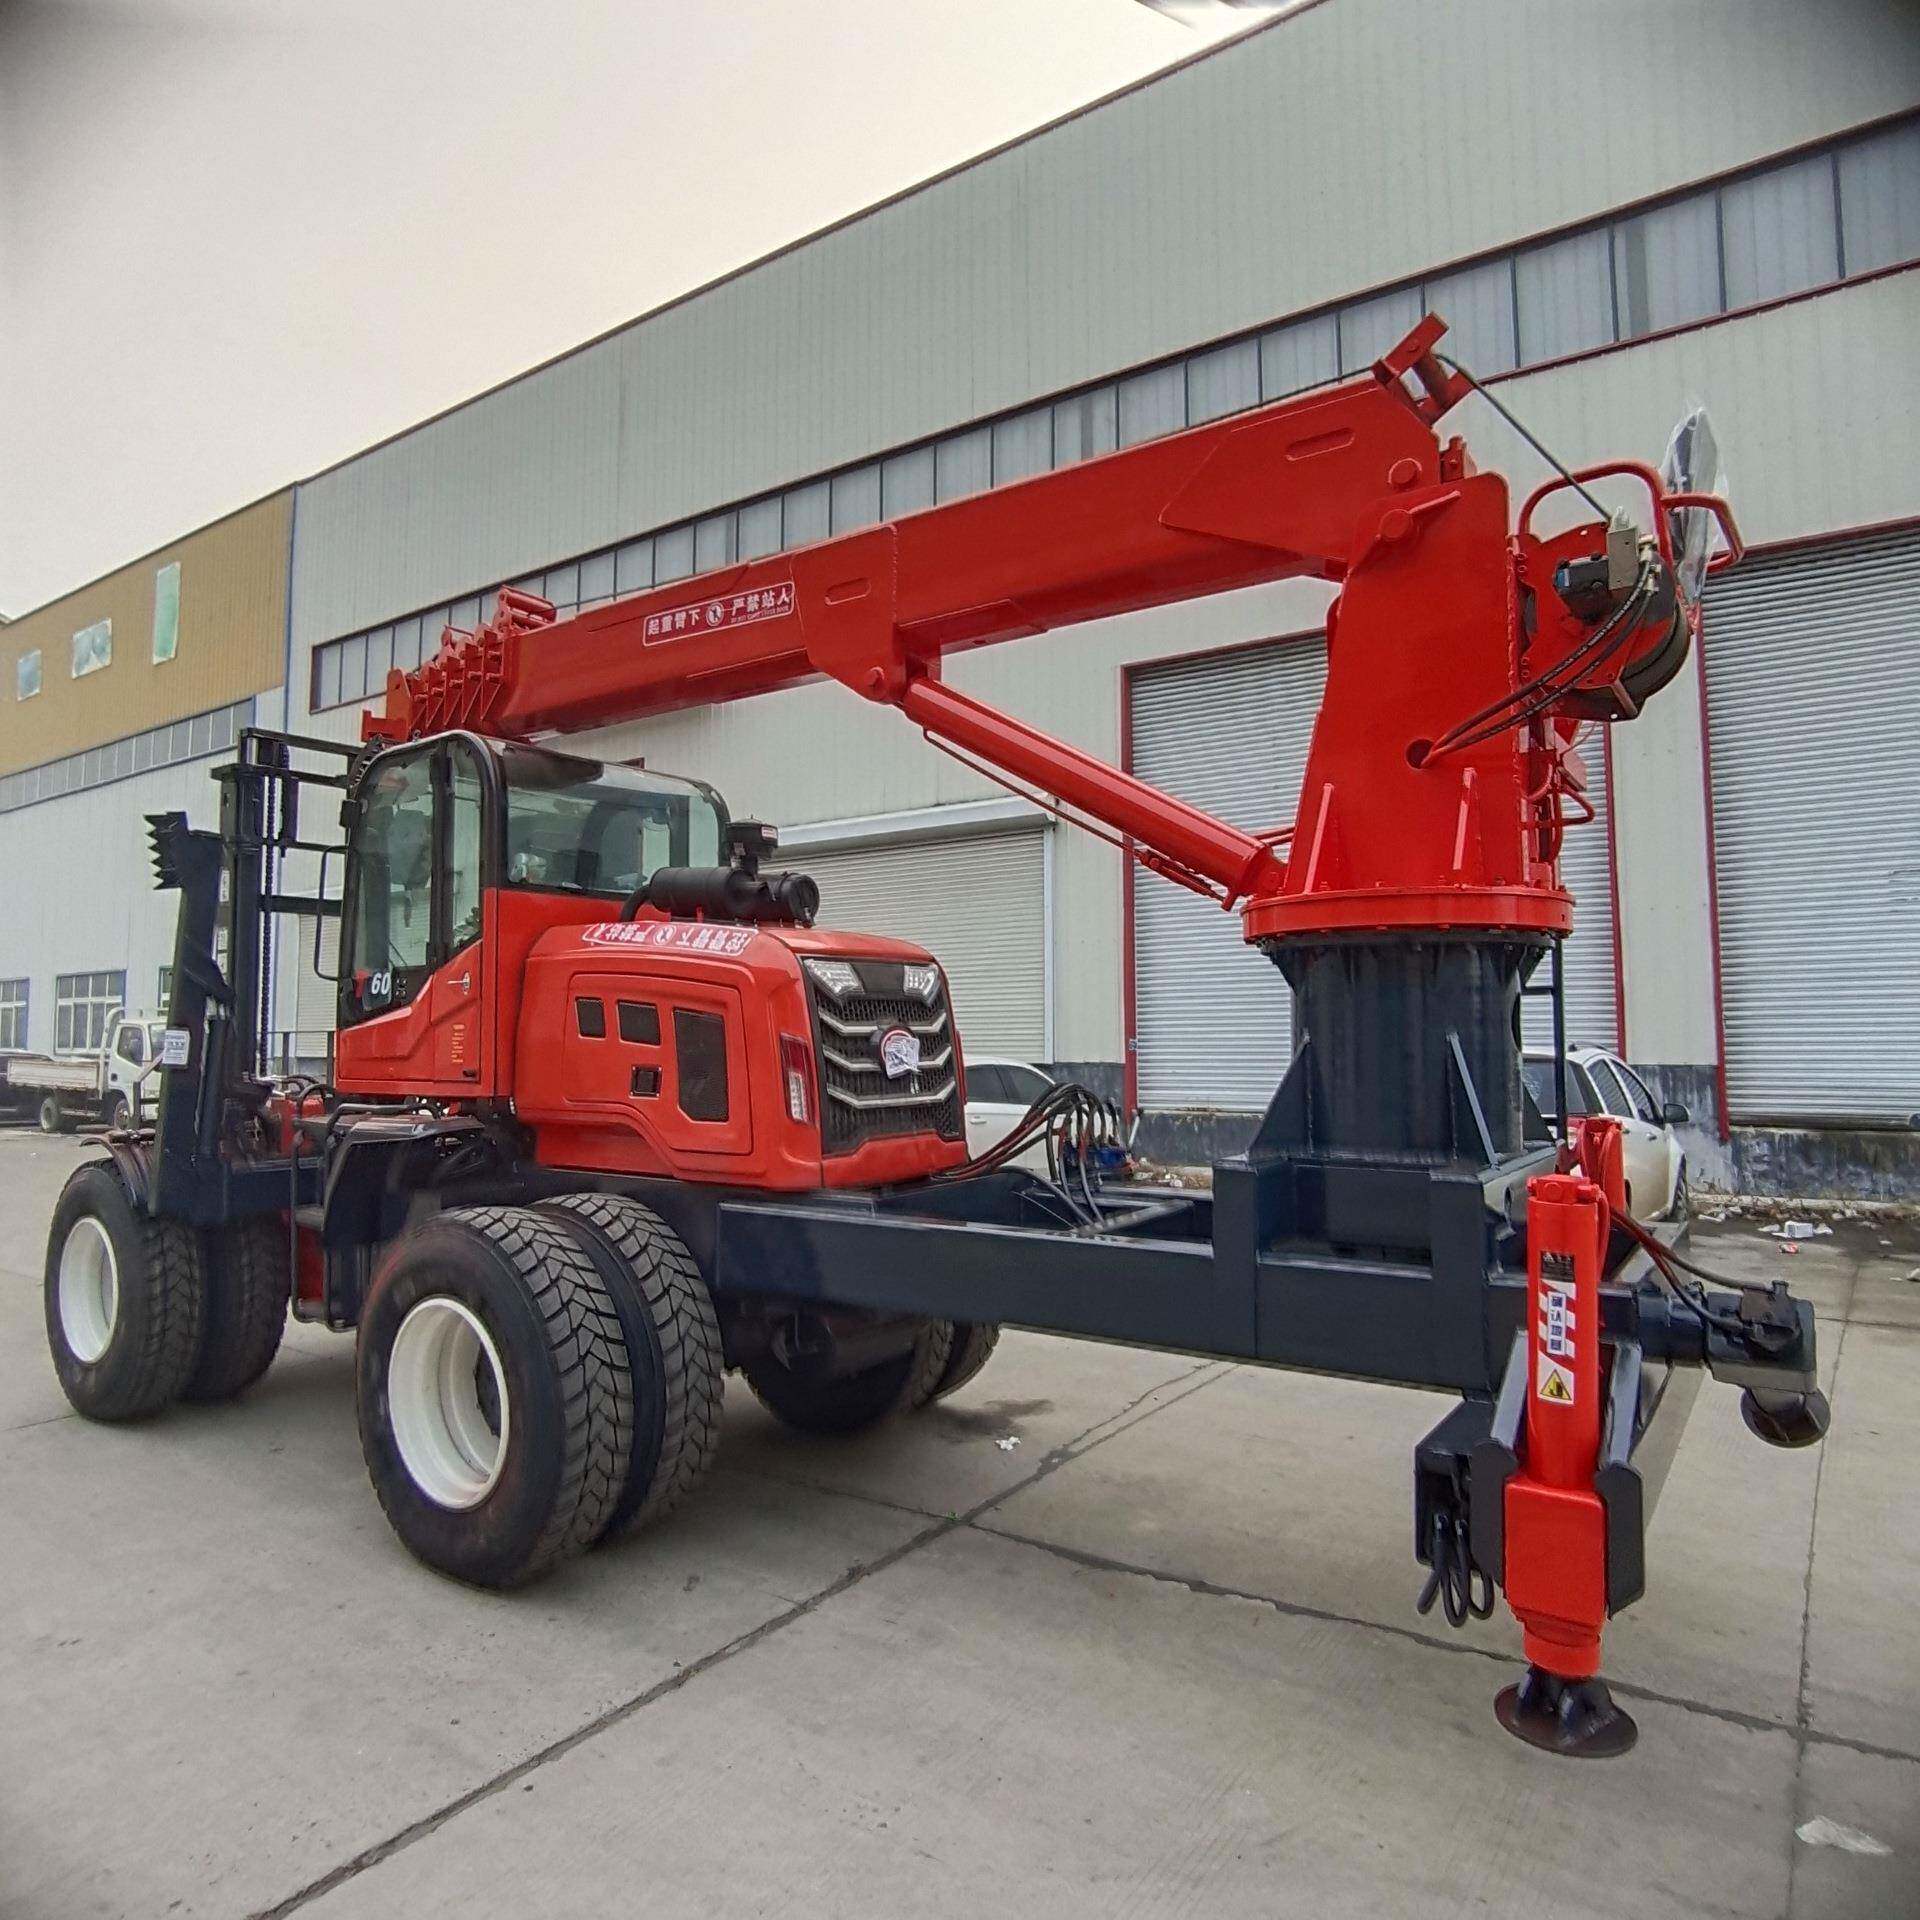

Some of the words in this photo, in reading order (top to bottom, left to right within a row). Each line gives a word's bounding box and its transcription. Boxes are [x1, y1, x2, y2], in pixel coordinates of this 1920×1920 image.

[732, 588, 790, 616] 严禁站人
[371, 972, 391, 995] 60
